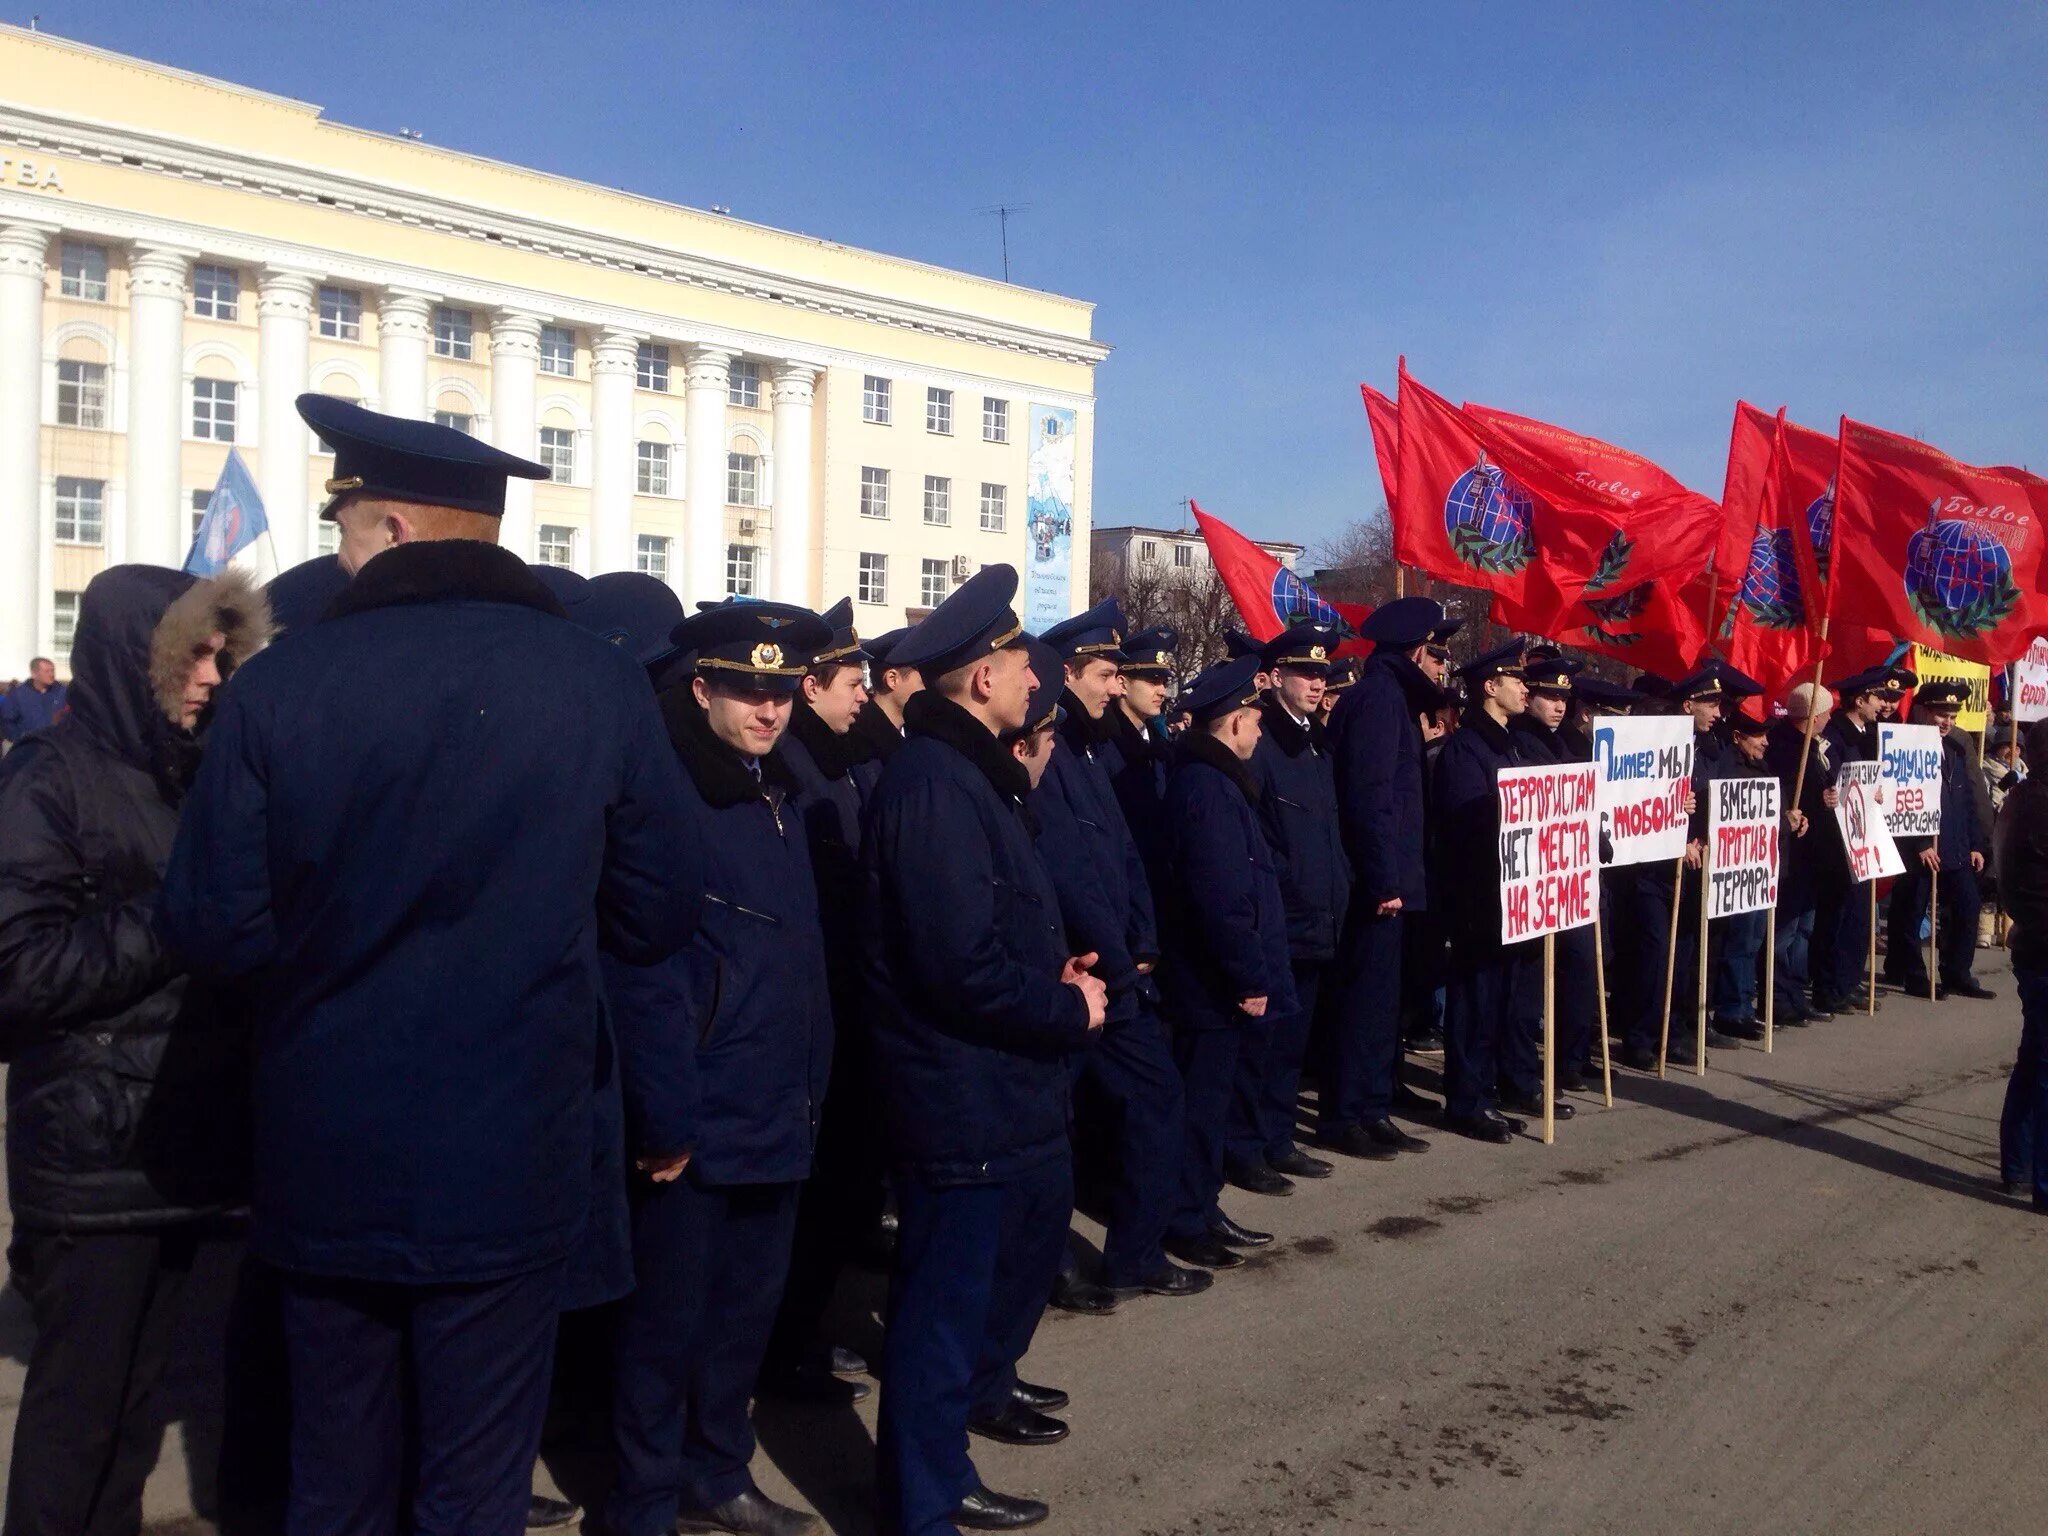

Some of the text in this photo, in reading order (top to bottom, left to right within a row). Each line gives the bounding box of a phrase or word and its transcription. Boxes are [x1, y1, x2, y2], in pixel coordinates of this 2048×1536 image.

[1575, 472, 1642, 499] Боевое
[1944, 496, 2030, 526] Боевое
[1499, 769, 1595, 824] ТЕРРОРИСТАМ
[1720, 780, 1776, 822] ВМЕСТЕ
[1501, 819, 1590, 882] НЕТ МЕСТА
[1507, 870, 1591, 938] НА ЗЕМЛЕ
